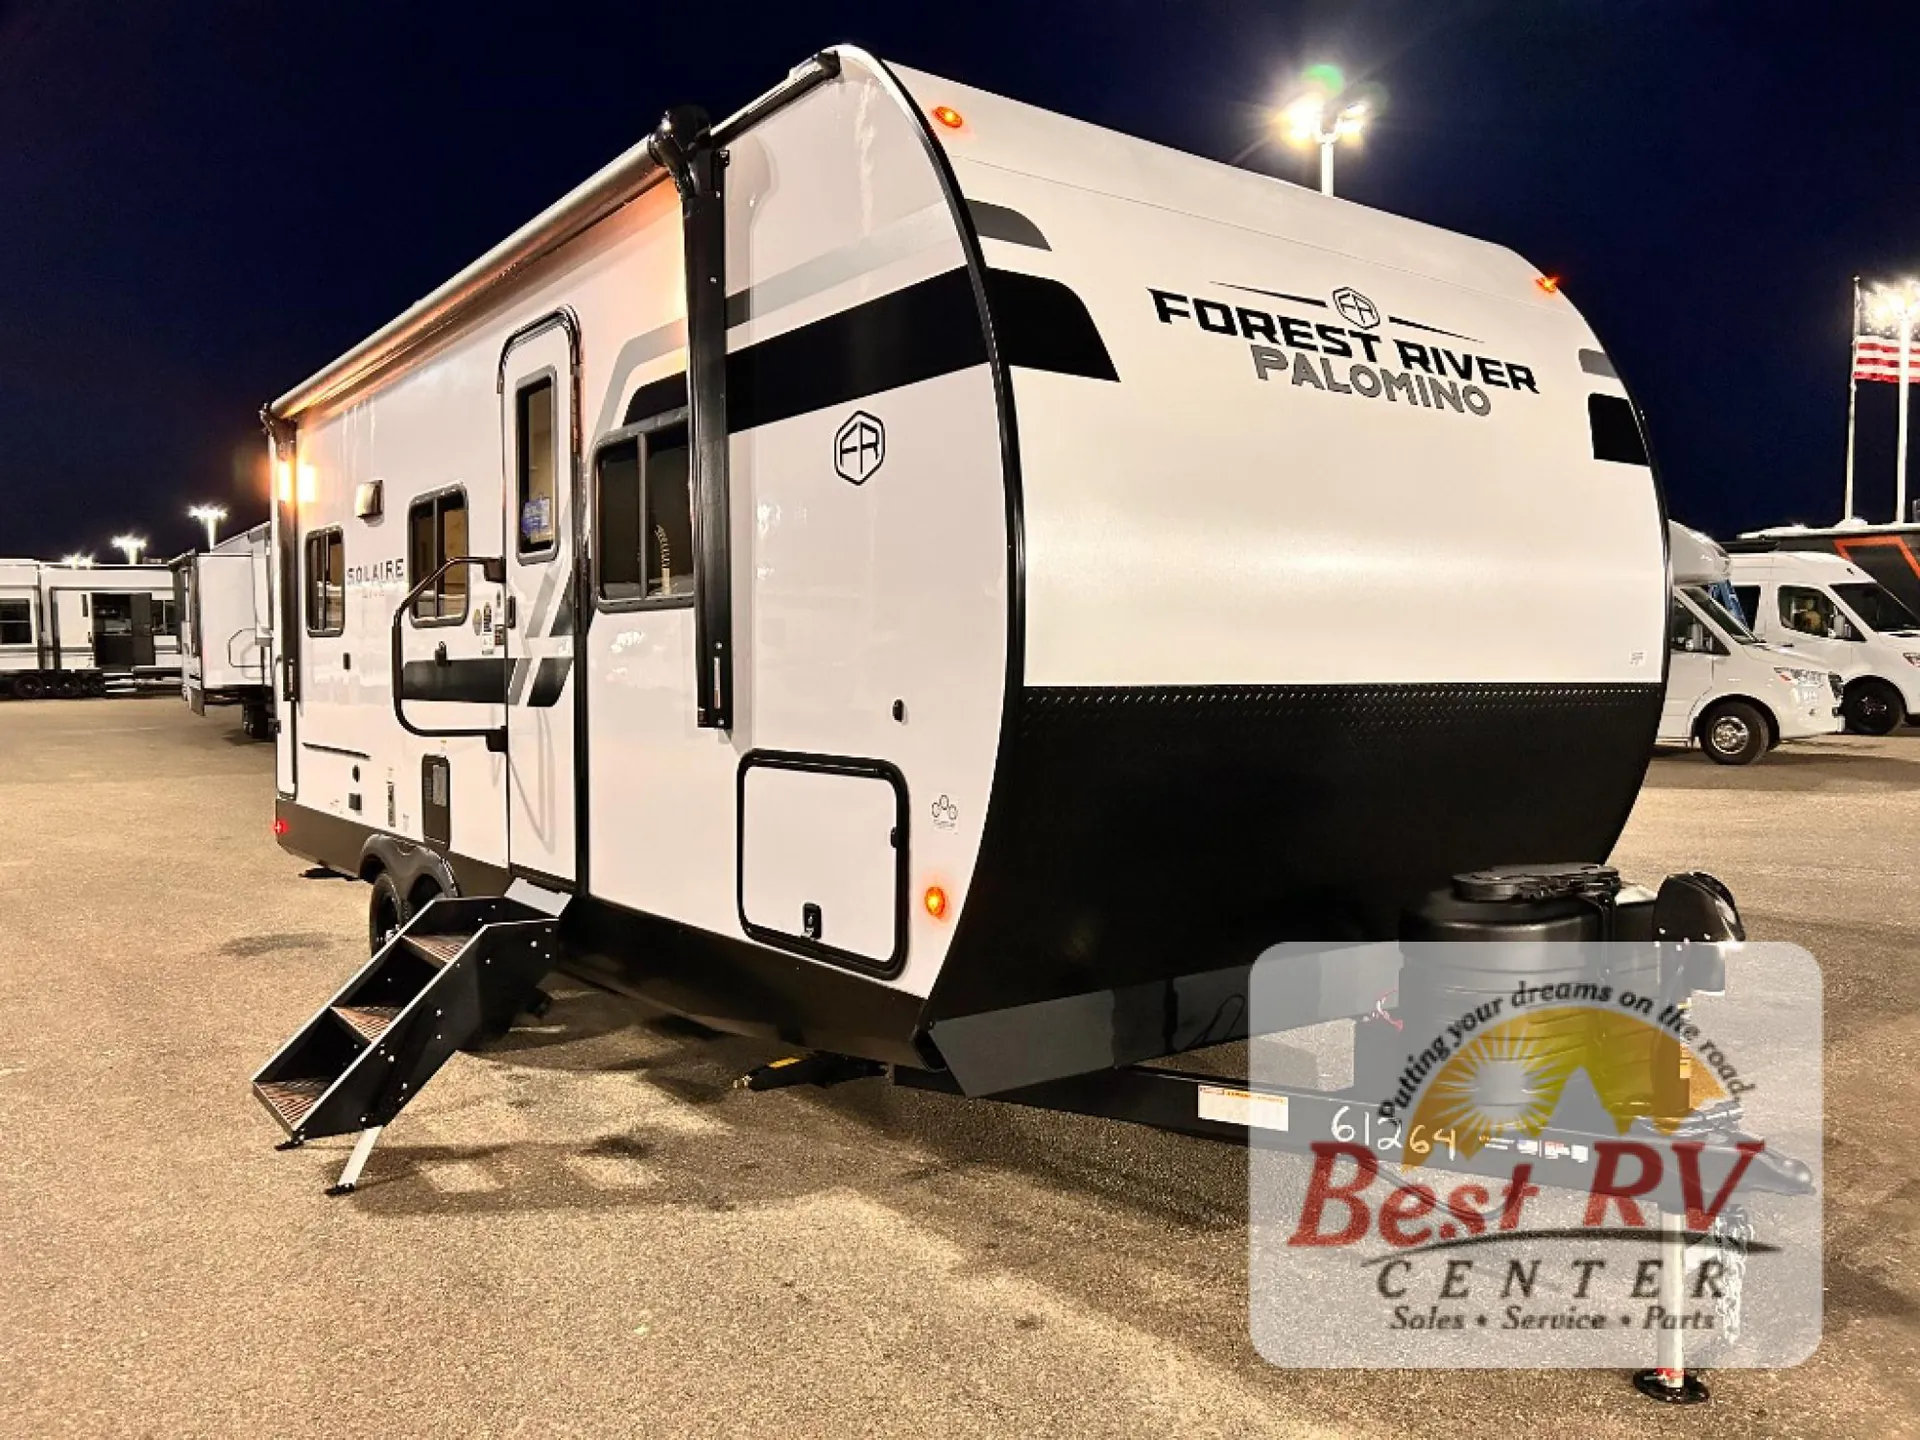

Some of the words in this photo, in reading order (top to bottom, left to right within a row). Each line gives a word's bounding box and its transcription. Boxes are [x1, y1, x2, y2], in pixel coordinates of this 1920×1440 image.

[1146, 287, 1382, 362] FOREST
[1393, 339, 1540, 394] RIVER
[1250, 344, 1492, 417] PALOMINO
[346, 558, 404, 585] SOLAIRE
[1331, 1105, 1457, 1162] 61264
